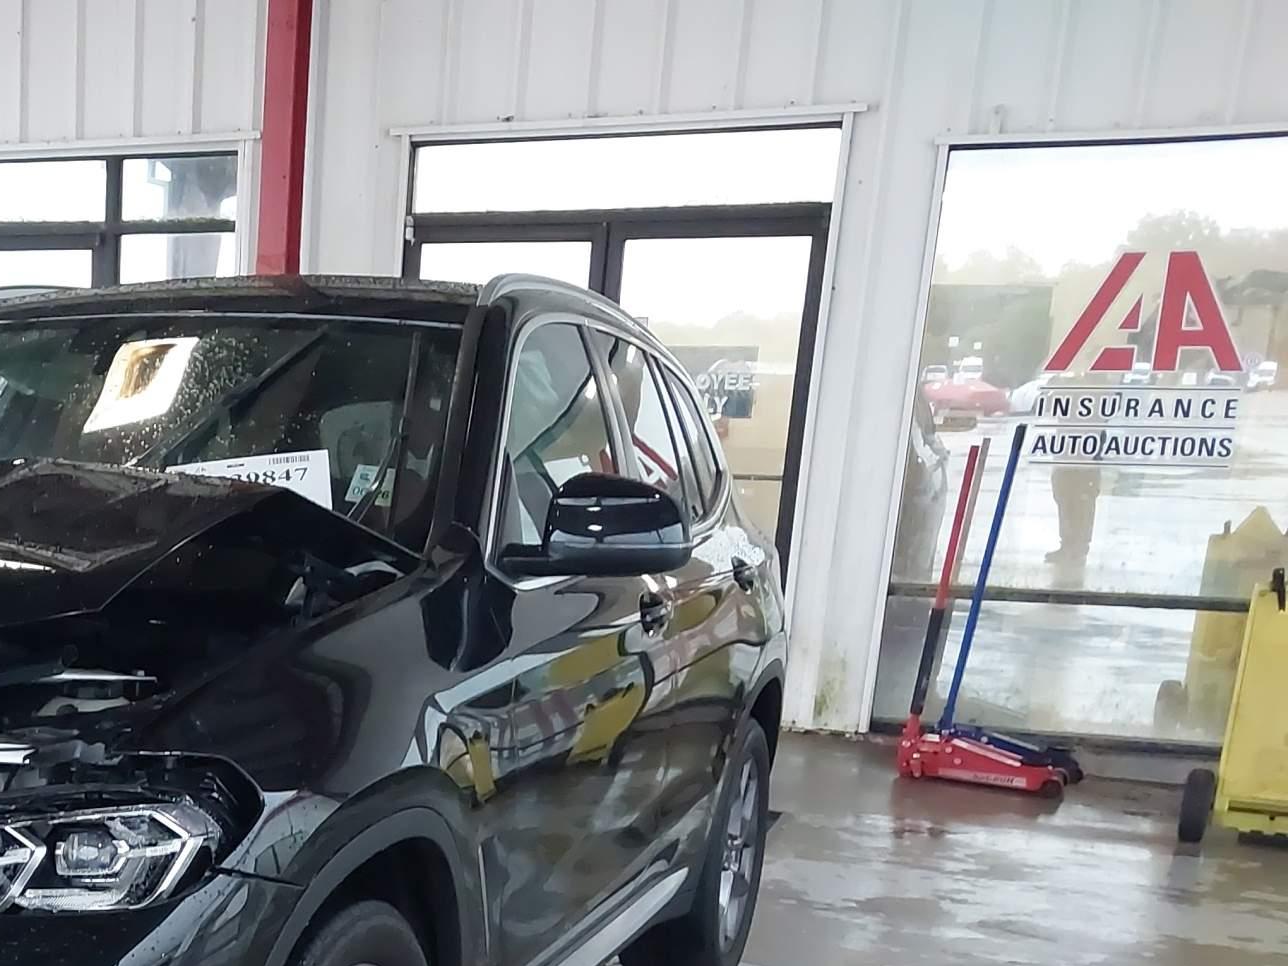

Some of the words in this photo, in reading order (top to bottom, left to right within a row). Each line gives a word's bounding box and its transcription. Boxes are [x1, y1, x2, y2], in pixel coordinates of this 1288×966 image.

[1037, 397, 1240, 419] INSURANCE
[1031, 435, 1098, 455] AUTO
[1105, 436, 1234, 458] AUCTIONS
